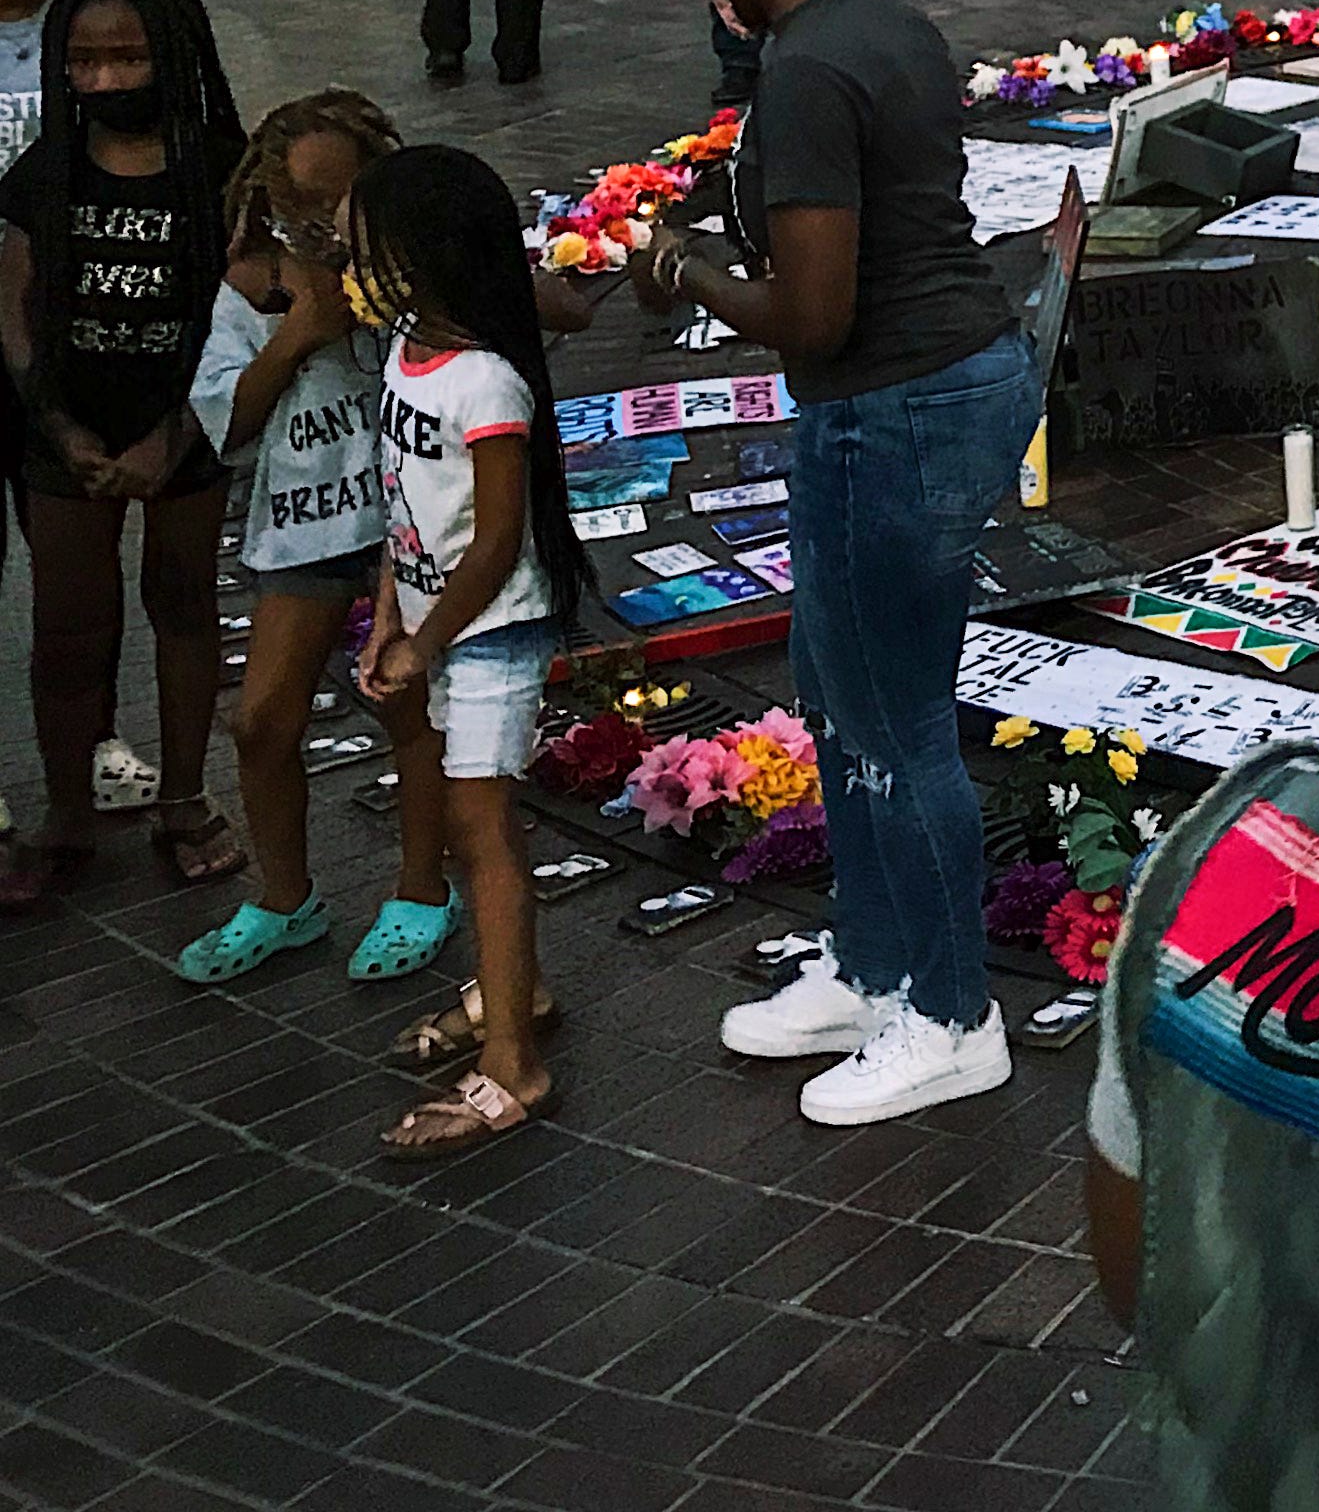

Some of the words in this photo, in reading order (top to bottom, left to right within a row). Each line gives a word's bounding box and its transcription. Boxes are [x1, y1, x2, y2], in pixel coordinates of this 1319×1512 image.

[1076, 275, 1284, 324] BREONNA
[289, 392, 370, 452] CAN'T
[684, 392, 731, 417] ARE
[964, 629, 1088, 666] FUCK
